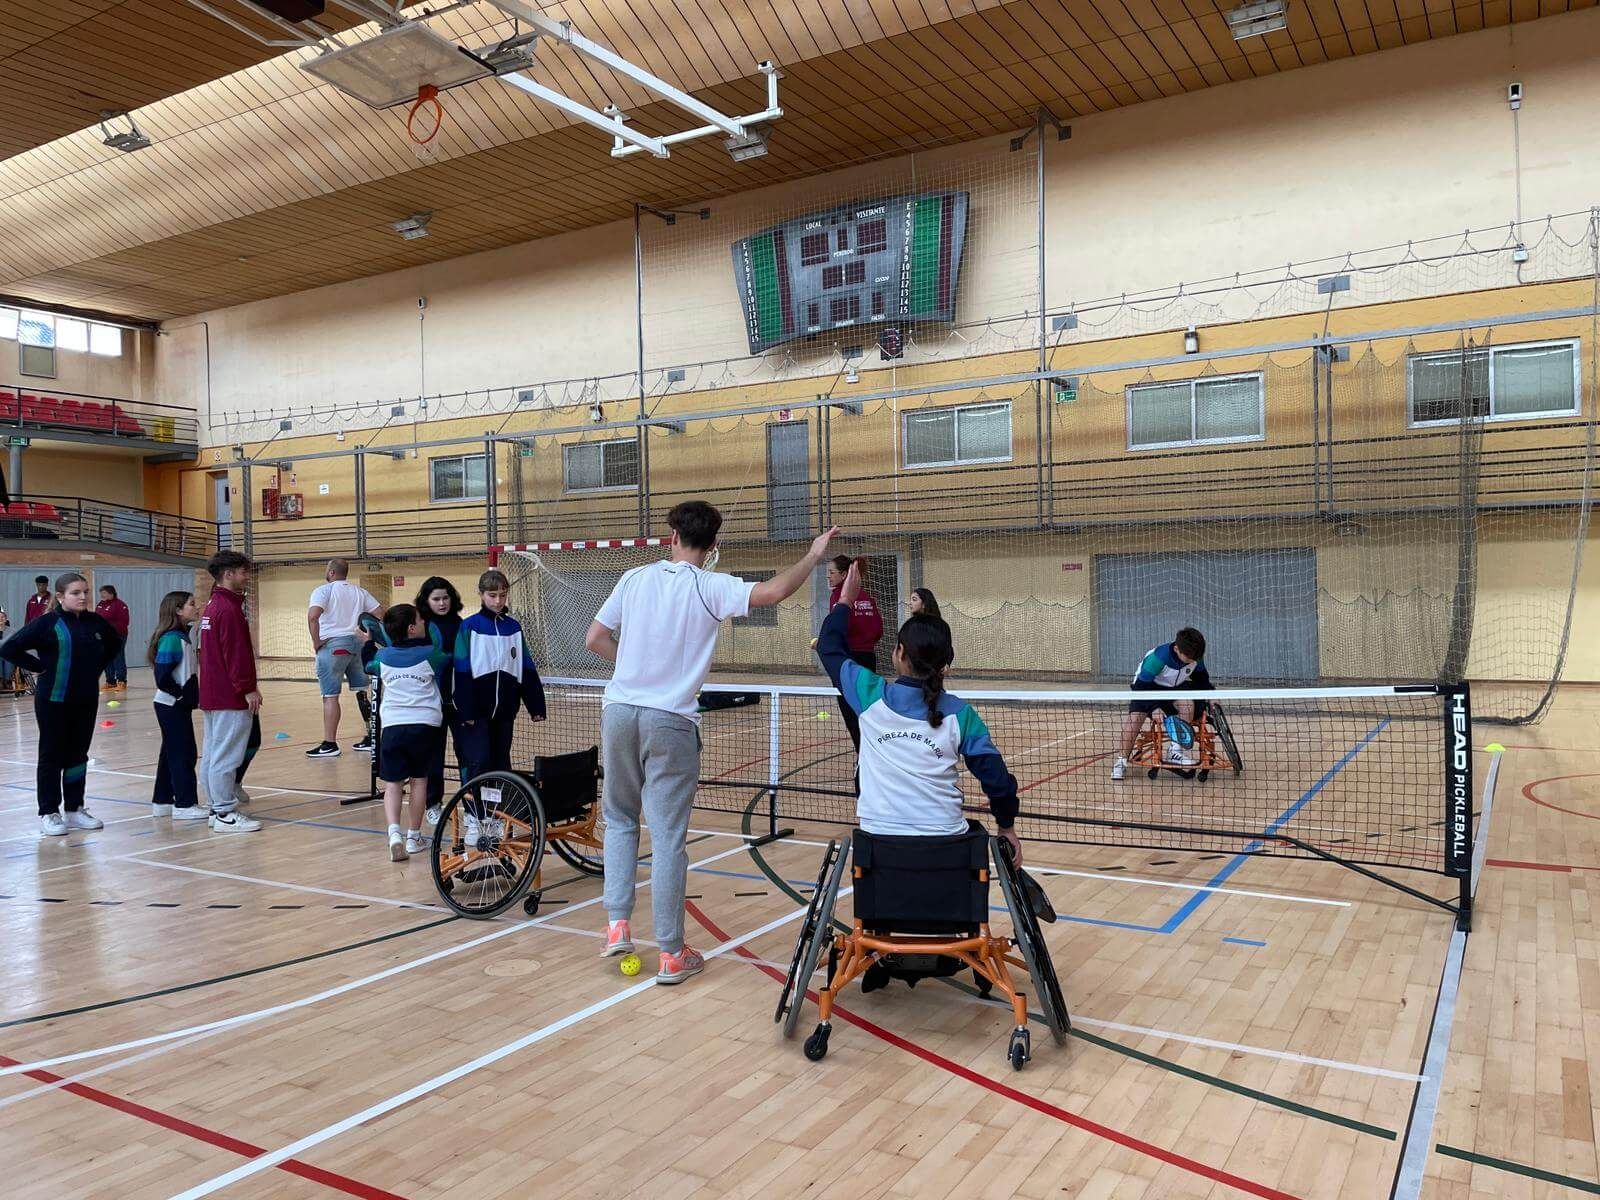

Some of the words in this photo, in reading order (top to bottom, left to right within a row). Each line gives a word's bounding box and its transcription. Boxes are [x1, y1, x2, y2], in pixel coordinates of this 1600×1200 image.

[856, 206, 886, 219] VISITANTE
[805, 221, 822, 230] LOCAL
[877, 731, 909, 744] PUREZA
[910, 732, 922, 741] DE
[1452, 693, 1467, 771] HEAD
[1453, 774, 1466, 858] PICKLEBALL
